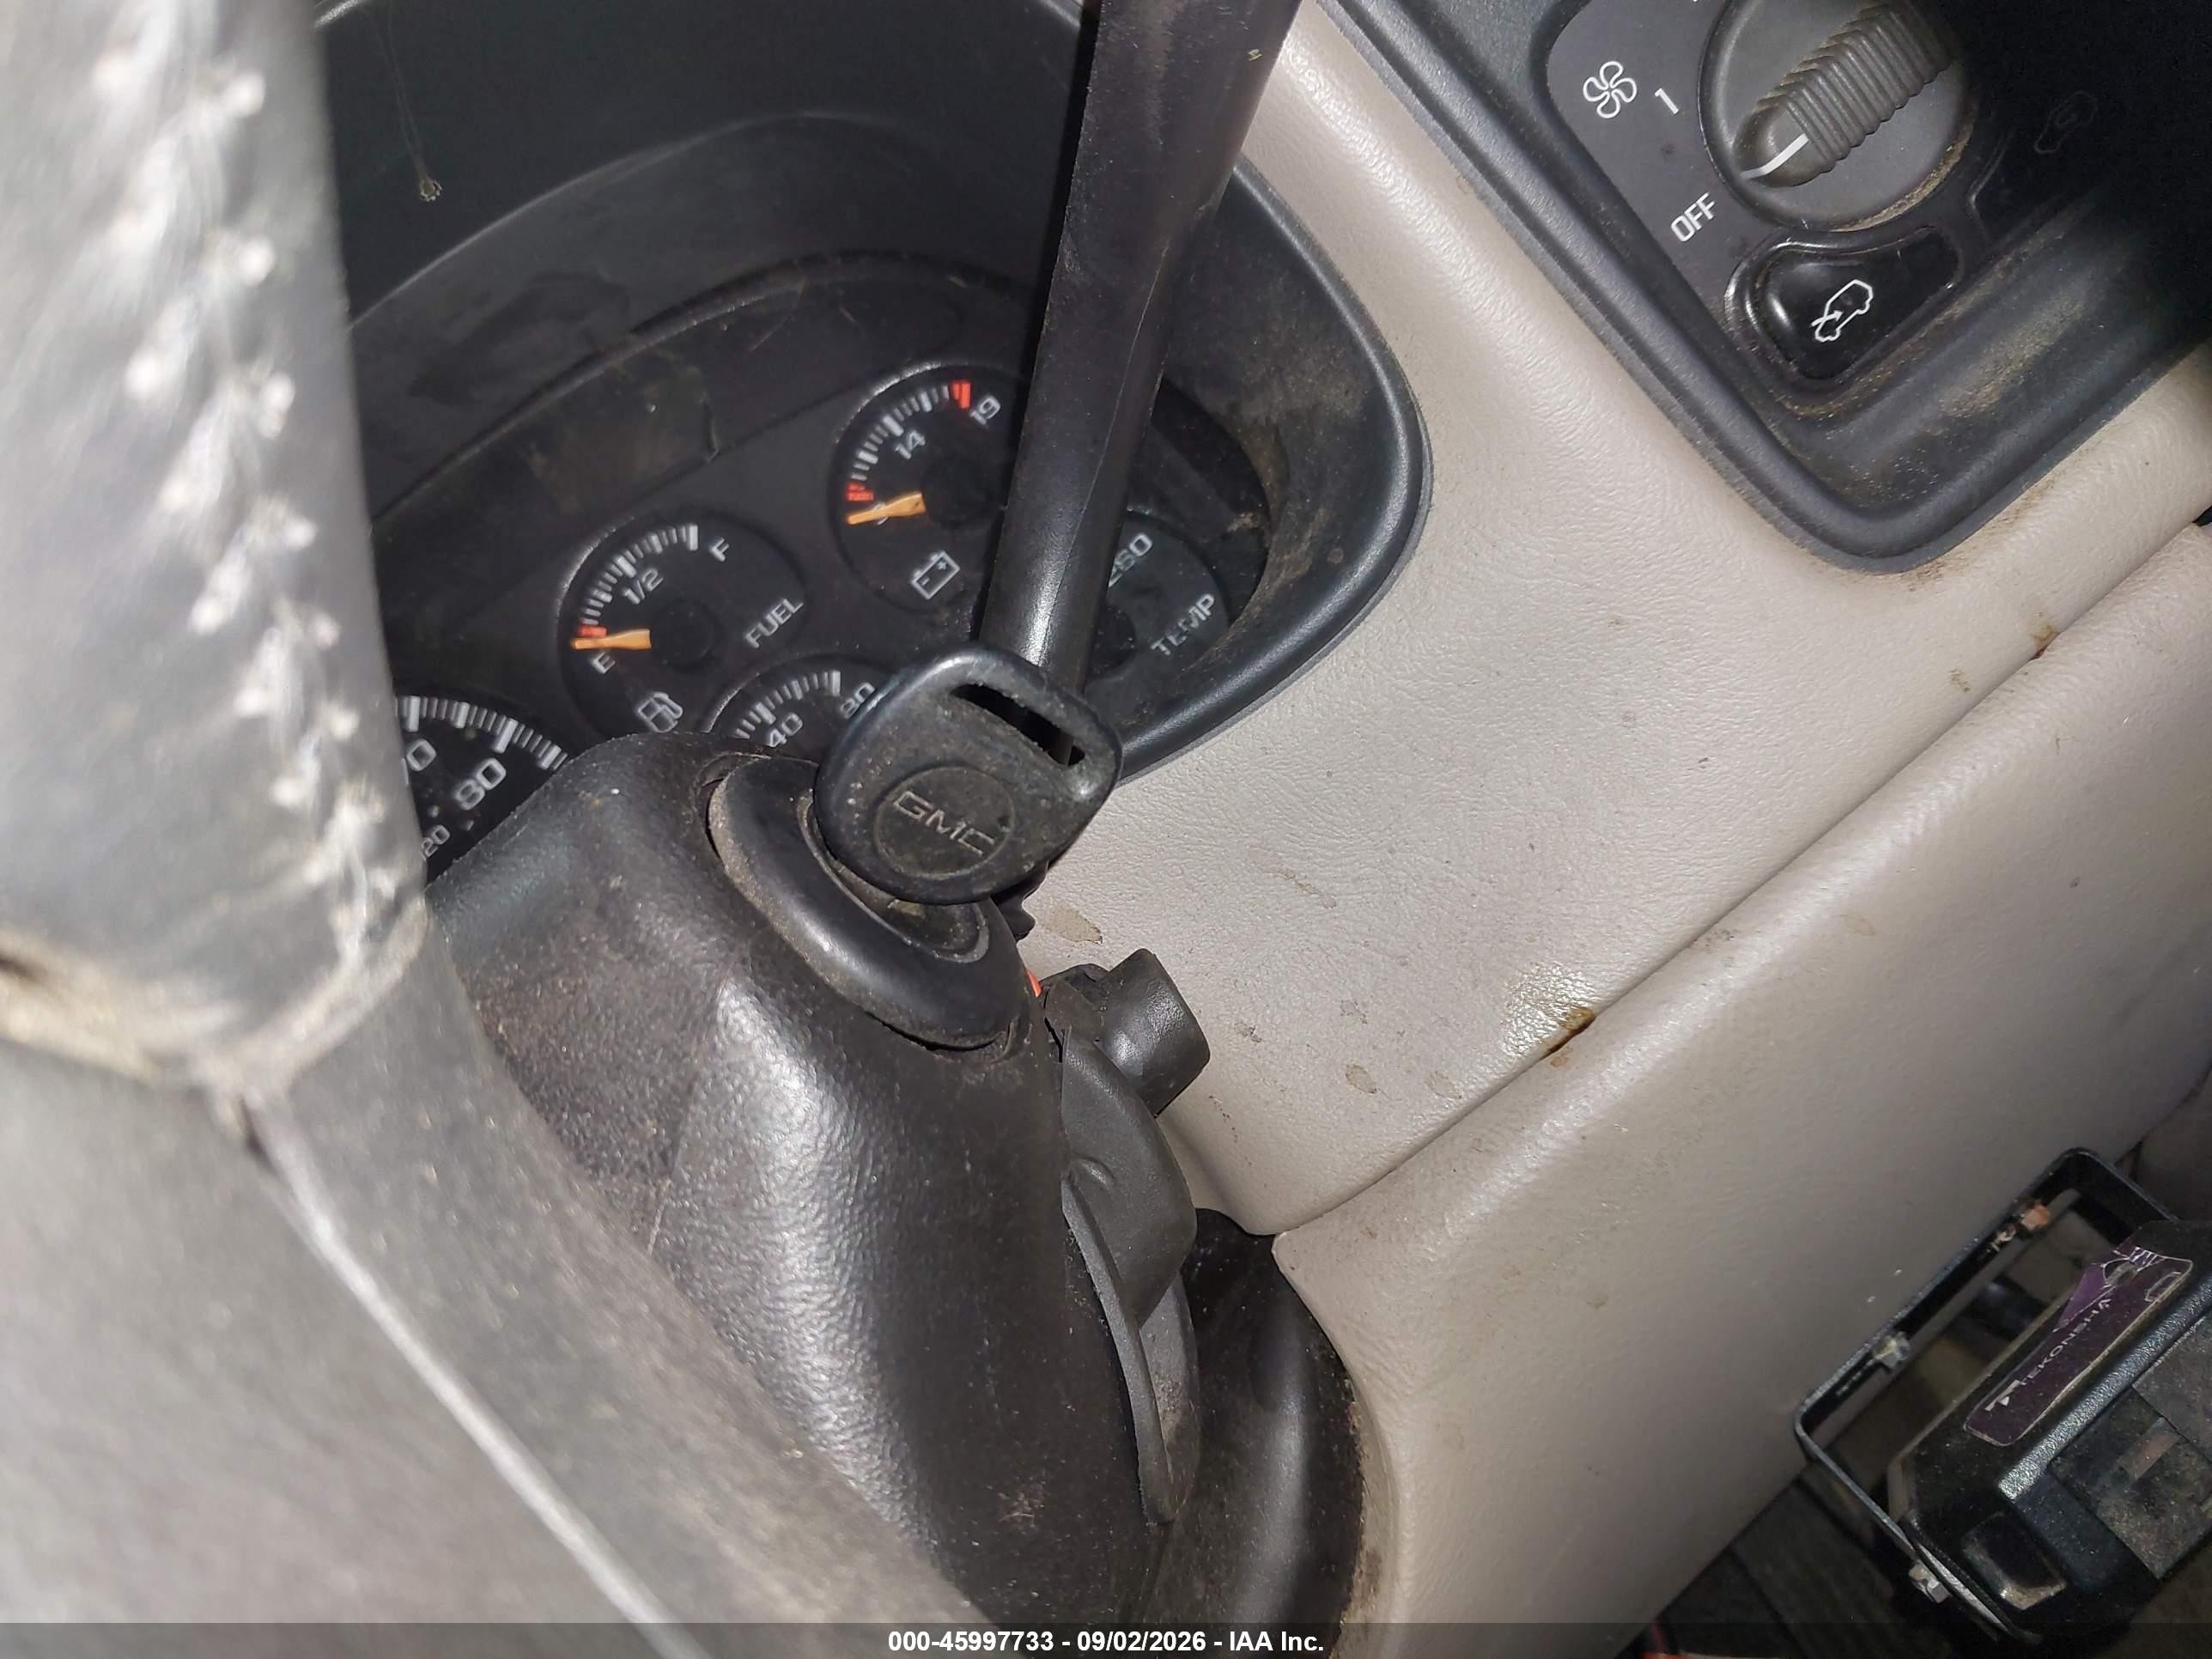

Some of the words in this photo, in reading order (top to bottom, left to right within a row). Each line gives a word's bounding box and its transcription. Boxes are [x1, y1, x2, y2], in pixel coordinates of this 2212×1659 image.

[1654, 88, 1680, 115] 1
[1670, 191, 1716, 243] OFF
[969, 395, 1001, 426] 19
[895, 430, 926, 459] 14
[708, 537, 730, 562] F
[623, 568, 664, 605] 1/2
[744, 598, 805, 648] FUEL
[1151, 593, 1215, 656] TEMP
[591, 652, 617, 674] E
[839, 682, 877, 720] 80
[768, 713, 804, 748] 40
[453, 757, 507, 811] 80
[893, 790, 996, 858] GMC
[2017, 1296, 2114, 1388] TEKONSHA
